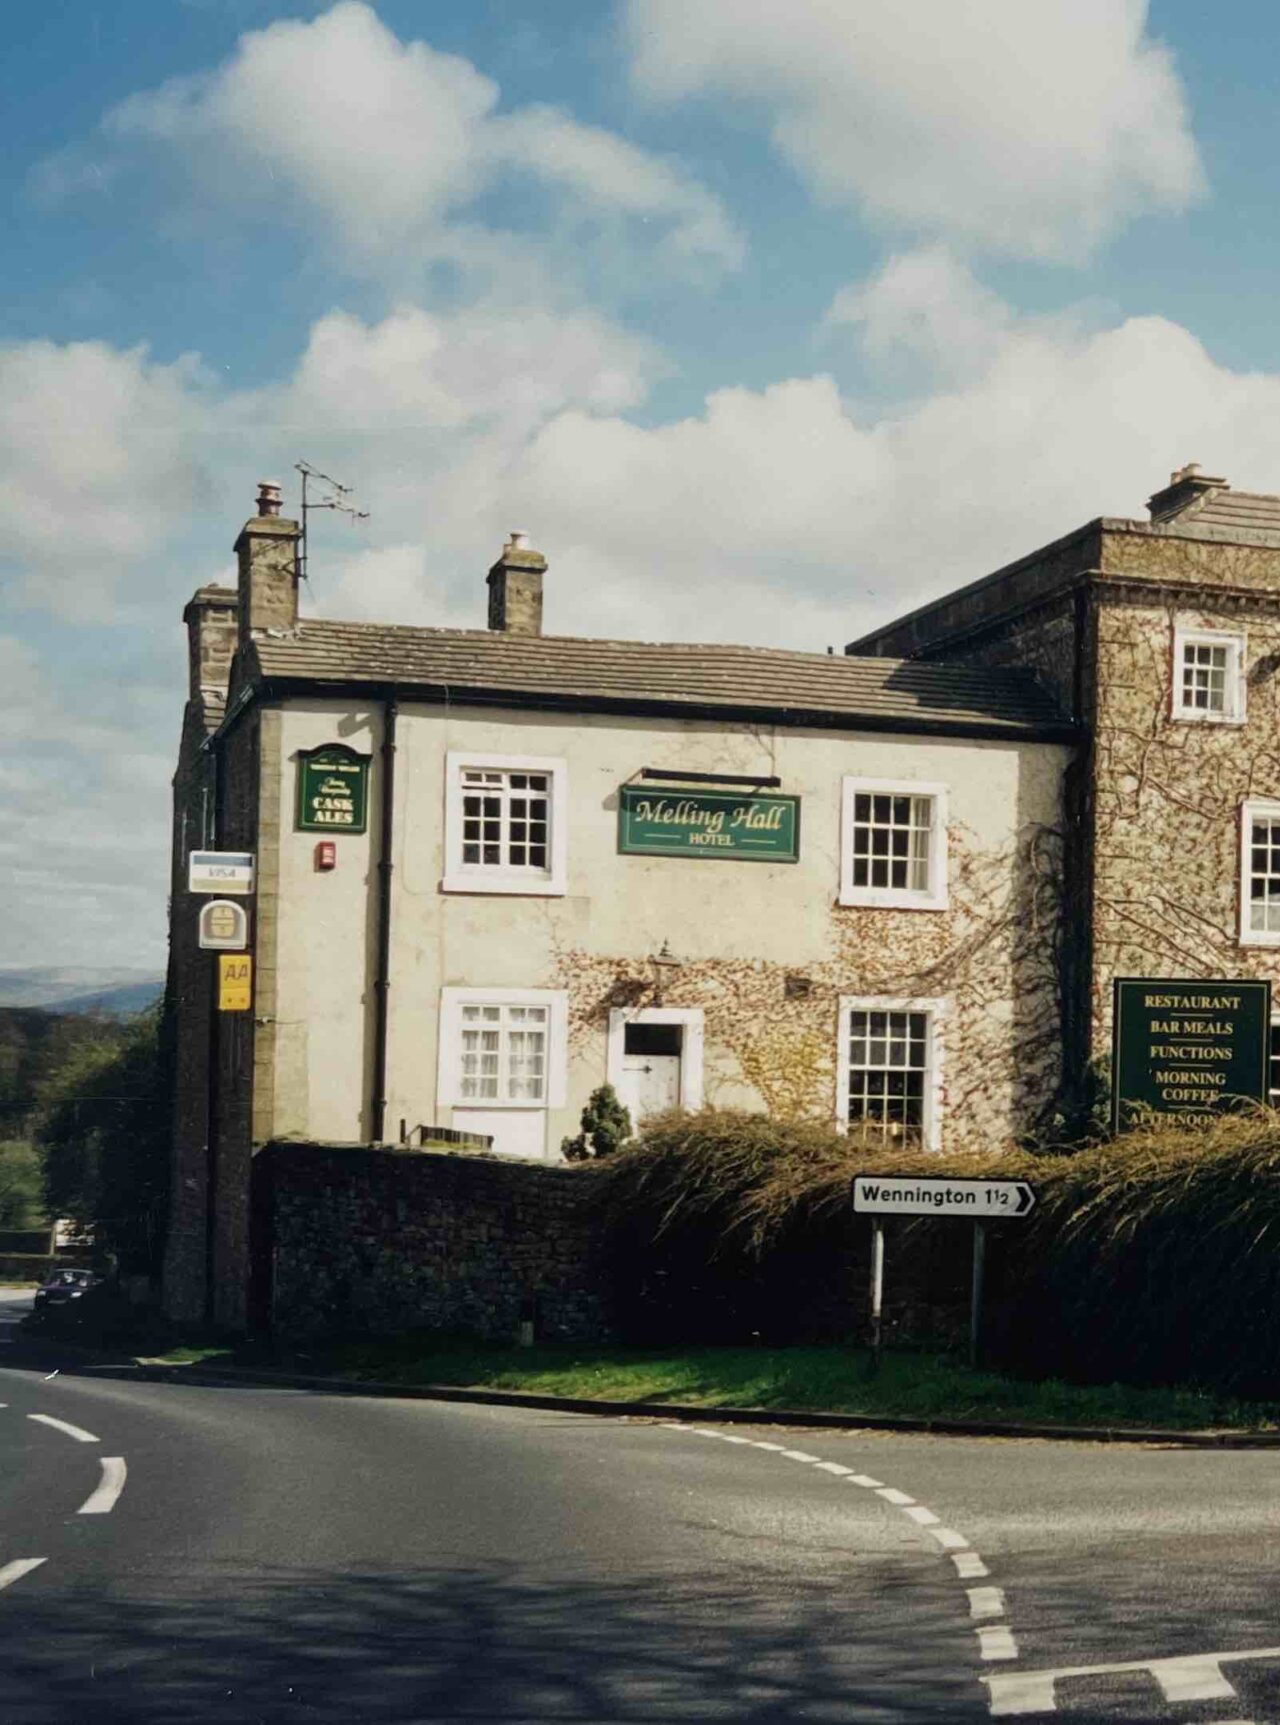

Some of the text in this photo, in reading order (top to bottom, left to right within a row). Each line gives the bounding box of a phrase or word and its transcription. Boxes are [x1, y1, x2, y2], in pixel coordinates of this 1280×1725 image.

[313, 797, 353, 810] CASK
[314, 810, 353, 824] ALES
[636, 801, 786, 833] Melling Hall
[689, 833, 735, 846] HOTEL
[225, 964, 248, 981] AA
[1144, 995, 1240, 1009] RESTAURANT
[1150, 1020, 1234, 1034] BAR MEALS
[1150, 1046, 1233, 1060] FUNCTIONS
[1156, 1071, 1226, 1085] MORNING
[1162, 1088, 1220, 1102] COFFEE
[862, 1185, 976, 1206] Wennington
